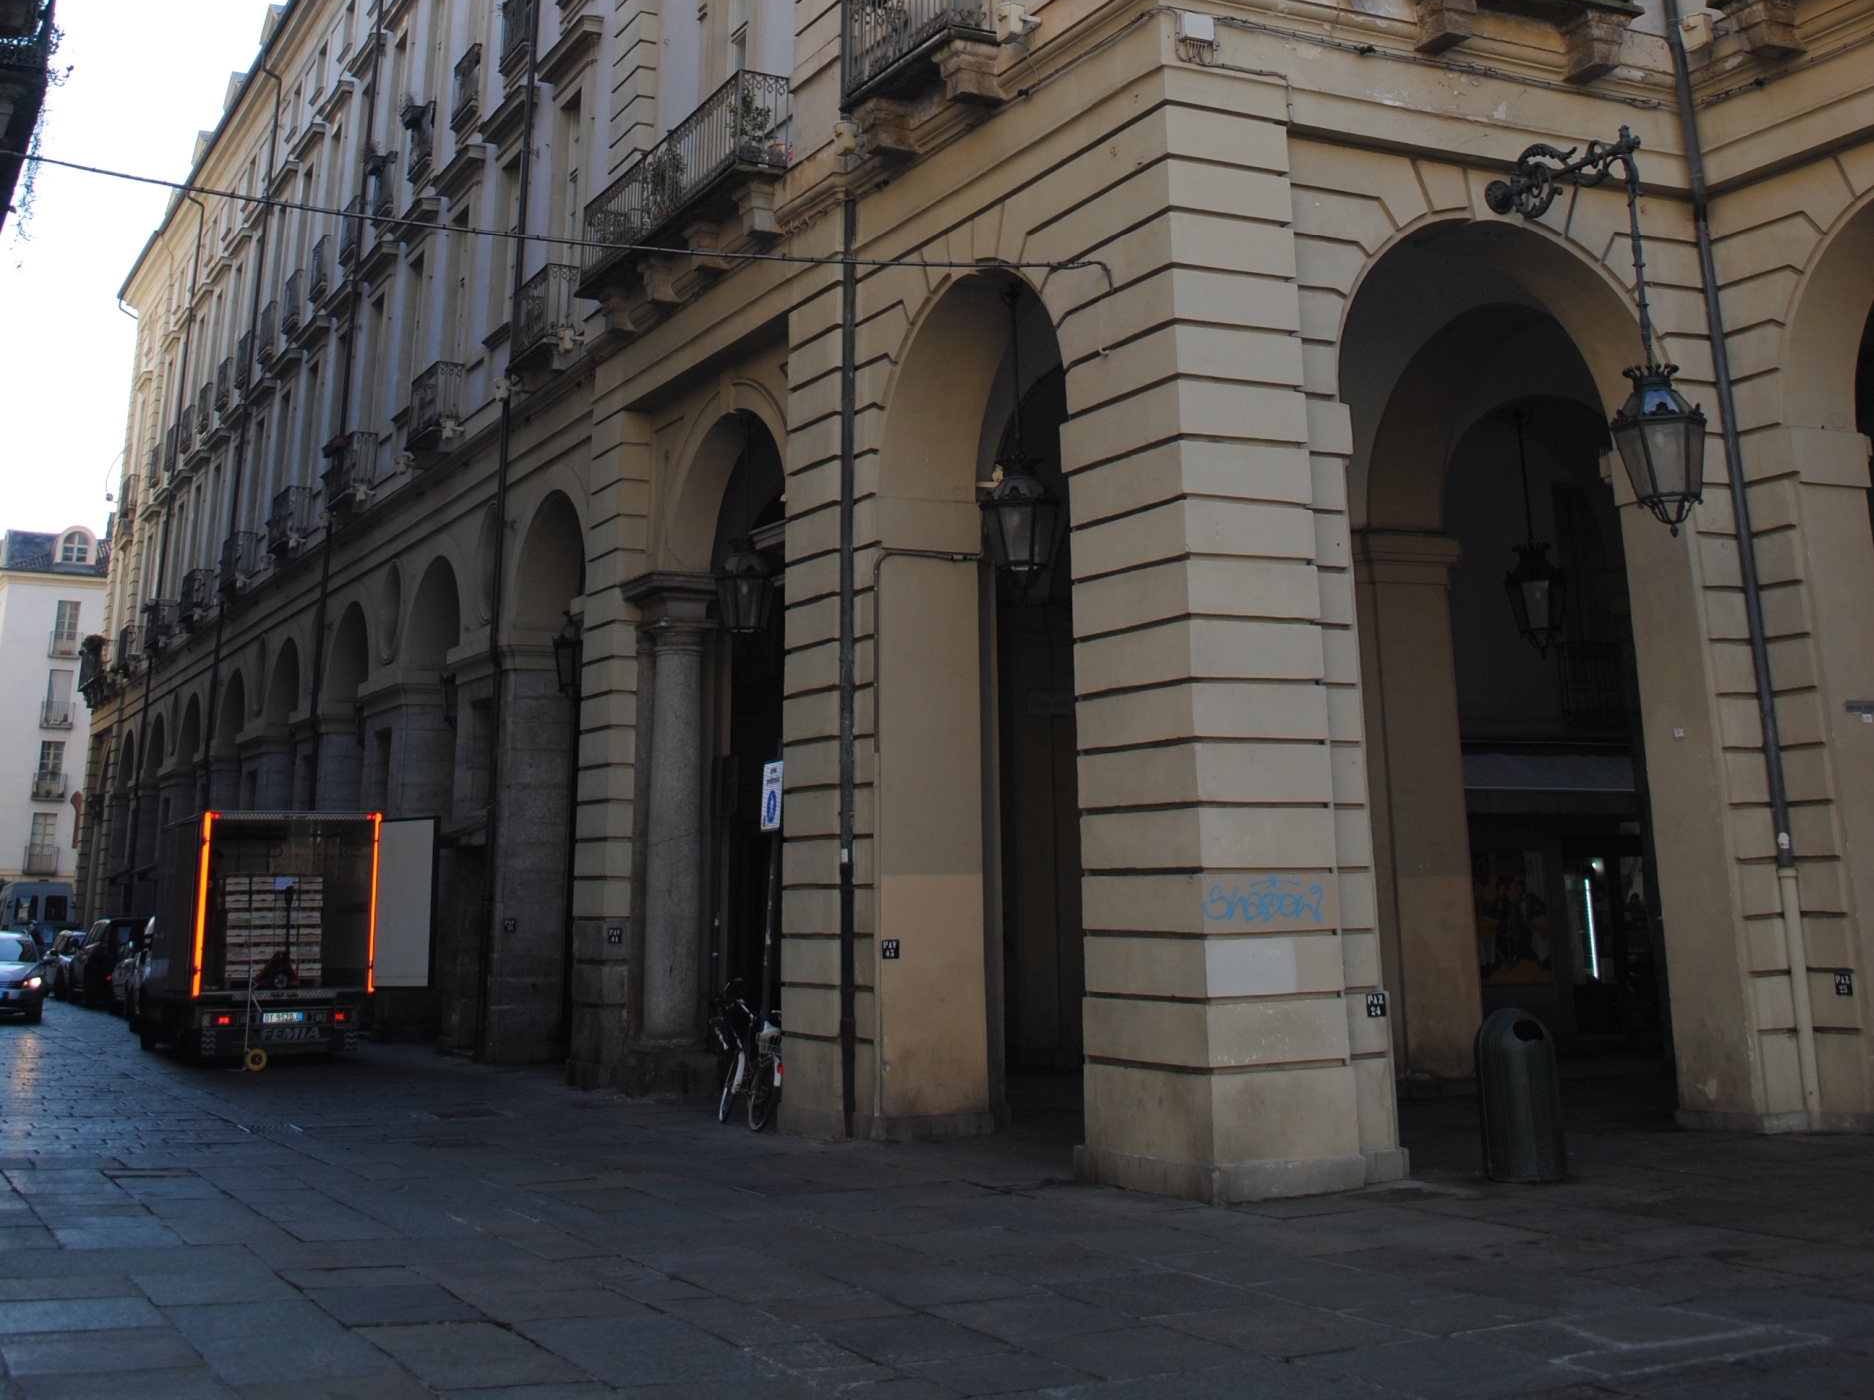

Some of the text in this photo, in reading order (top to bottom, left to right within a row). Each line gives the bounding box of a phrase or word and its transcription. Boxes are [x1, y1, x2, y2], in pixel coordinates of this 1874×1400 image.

[883, 940, 898, 949] PAV
[1835, 975, 1850, 984] PAZ
[1367, 994, 1384, 1005] PAZ
[1370, 1005, 1381, 1016] 24
[262, 1027, 320, 1040] FEMIA
